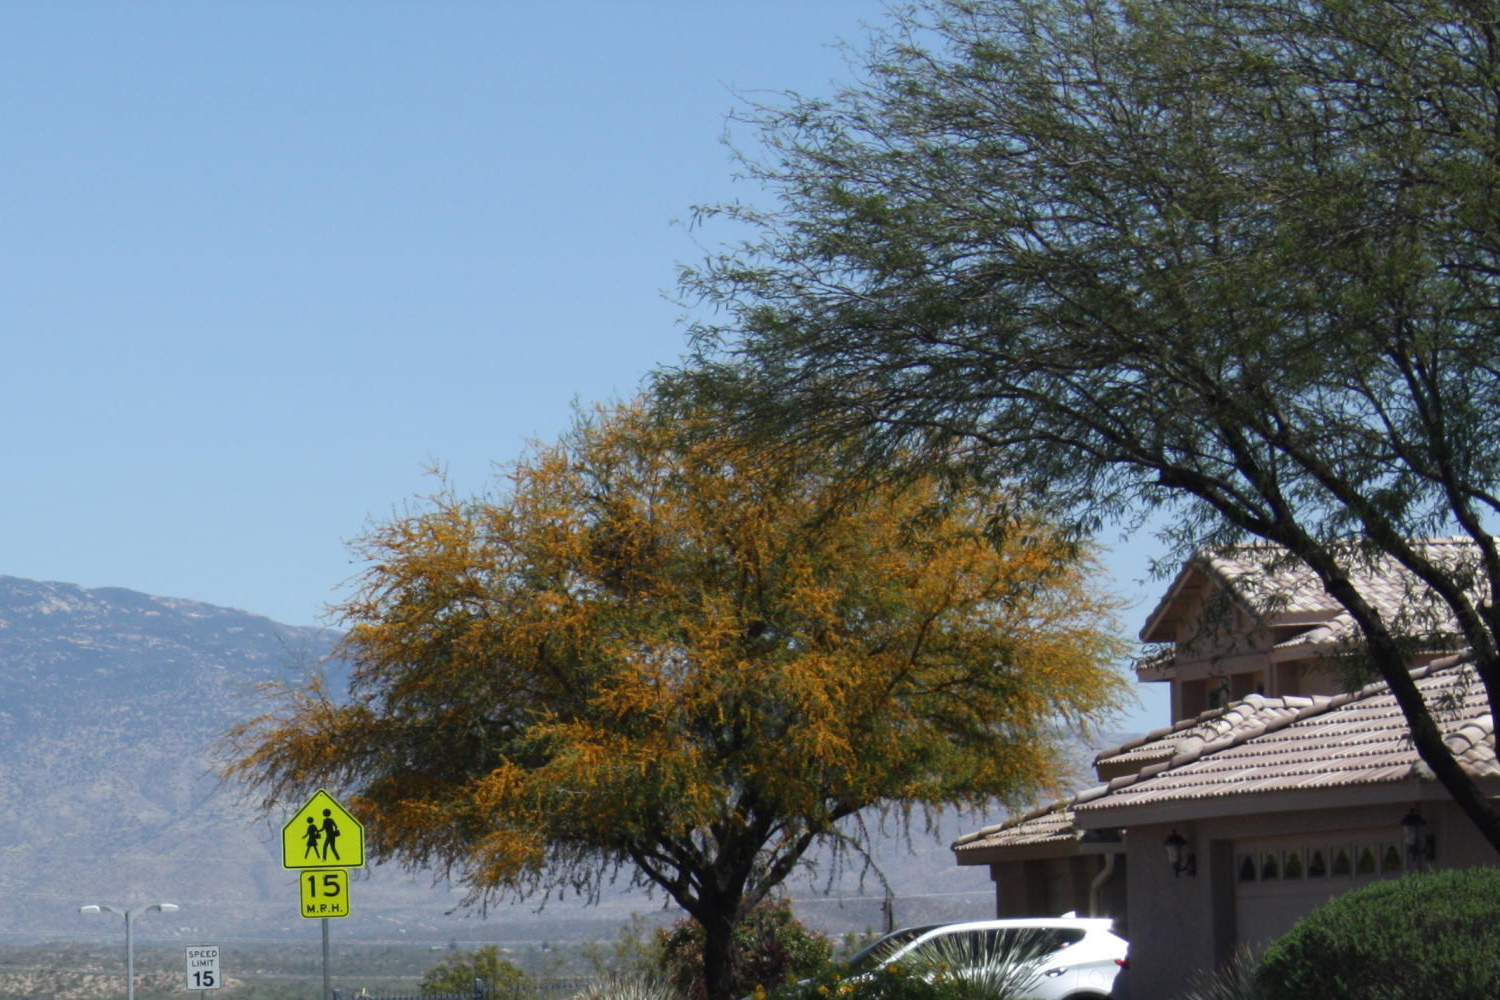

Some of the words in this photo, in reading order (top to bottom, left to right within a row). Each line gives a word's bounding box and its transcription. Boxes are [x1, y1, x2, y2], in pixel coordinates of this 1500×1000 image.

[308, 874, 341, 898] 15
[307, 903, 344, 914] M.P.H.
[188, 950, 218, 958] SPEED
[191, 959, 214, 967] LIMIT
[193, 970, 214, 987] 15
